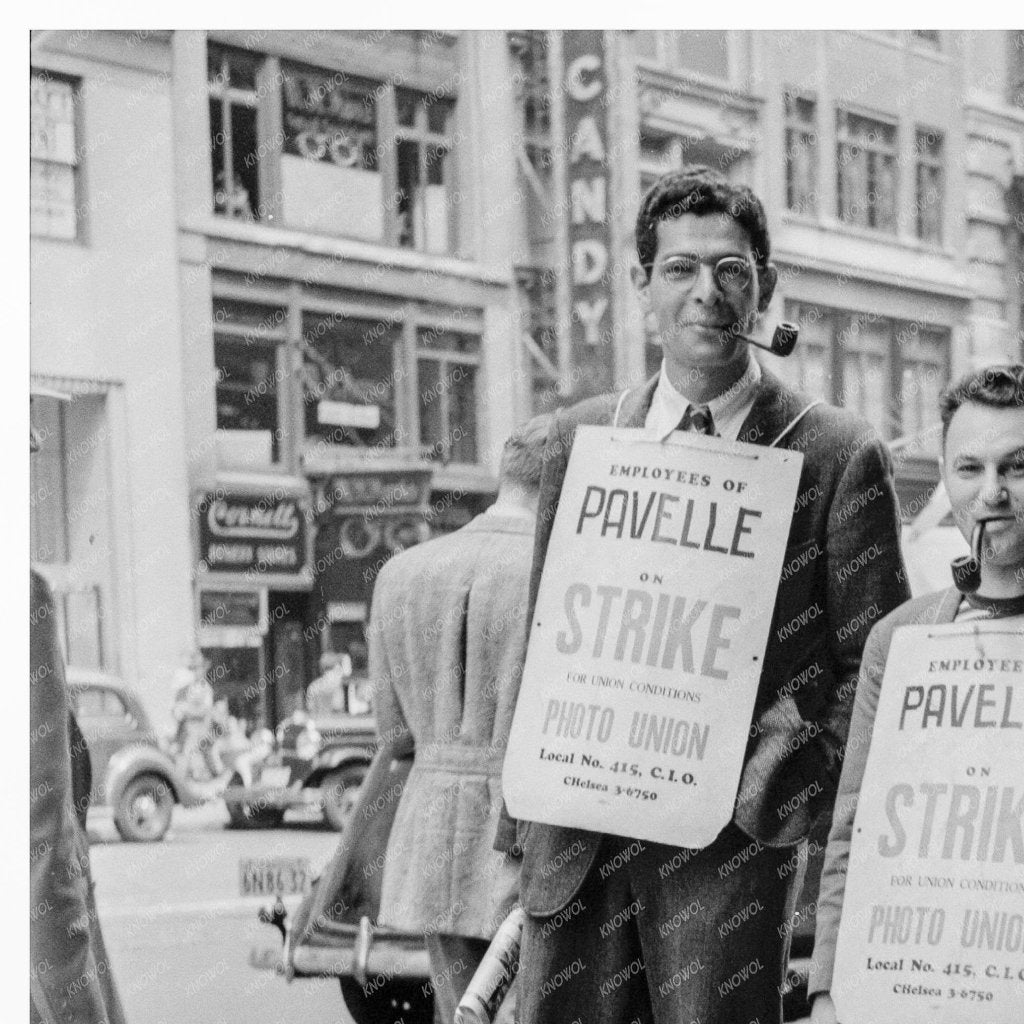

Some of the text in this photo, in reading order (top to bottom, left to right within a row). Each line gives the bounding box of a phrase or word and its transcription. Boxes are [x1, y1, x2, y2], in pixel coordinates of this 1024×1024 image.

[566, 54, 609, 345] CANDY
[609, 464, 748, 494] EMPLOYEES OF
[576, 485, 762, 559] PAVELLE
[639, 572, 664, 585] ON
[555, 582, 741, 681] STRIKE
[566, 672, 702, 702] FOR UNION CONDITIONS
[542, 699, 711, 760] PHOTO UNION
[539, 748, 698, 786] Local No. 415, C.I.O.
[966, 766, 991, 777] ON
[563, 776, 658, 801] CHelsea 3-6750
[890, 875, 912, 887] FOR
[918, 876, 954, 889] UNION
[867, 904, 946, 946] PHOTO
[866, 957, 904, 971] Local
[910, 959, 935, 973] No.
[893, 983, 942, 997] CHelsea
